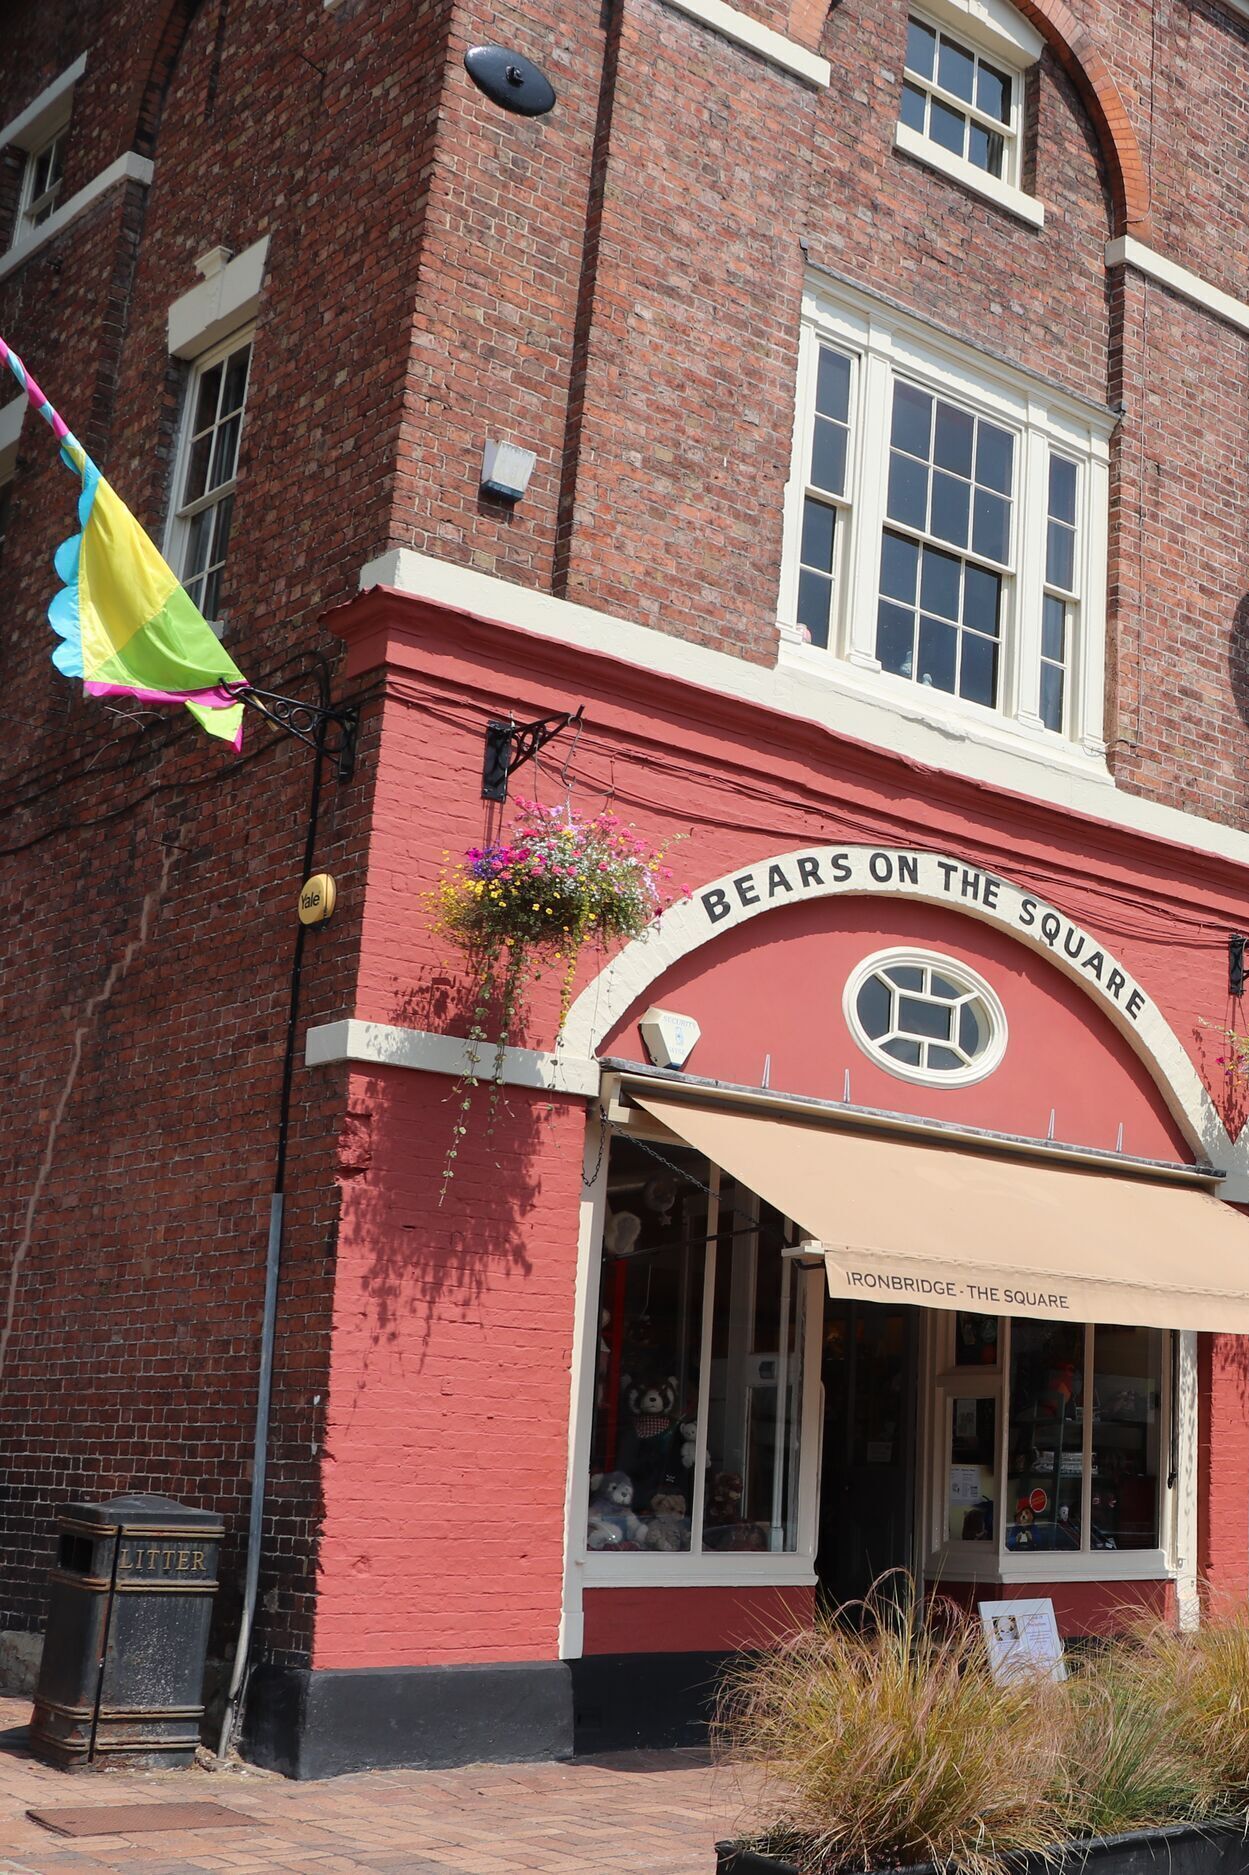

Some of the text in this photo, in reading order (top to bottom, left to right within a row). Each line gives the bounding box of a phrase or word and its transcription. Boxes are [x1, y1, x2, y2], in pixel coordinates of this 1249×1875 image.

[301, 891, 321, 910] Yale
[701, 852, 1156, 1020] BEARS ON THE SQUARE
[846, 1272, 957, 1297] IRONBRIDGE
[967, 1284, 1001, 1302] THE
[1003, 1289, 1070, 1309] SQUARE
[118, 1548, 207, 1571] LITTER
